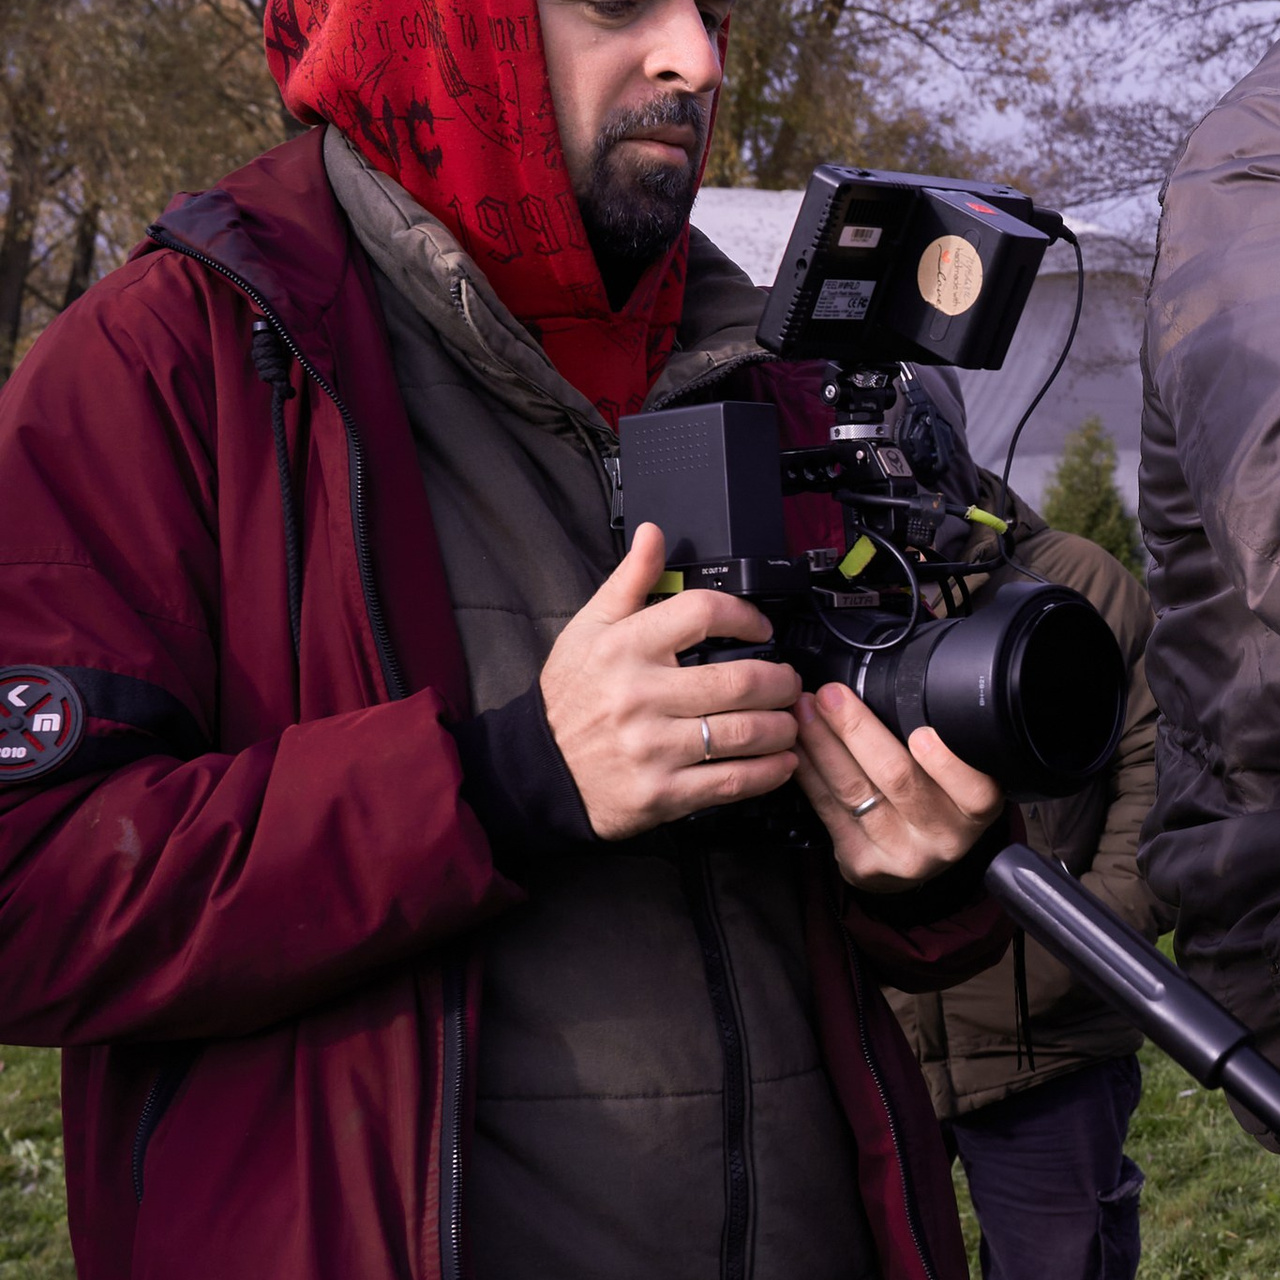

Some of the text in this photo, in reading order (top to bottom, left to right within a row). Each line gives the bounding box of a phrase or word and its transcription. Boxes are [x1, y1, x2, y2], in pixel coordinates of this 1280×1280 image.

[375, 20, 392, 52] IT
[458, 10, 479, 52] TO
[952, 247, 963, 290] handmade
[842, 595, 874, 606] TILTA
